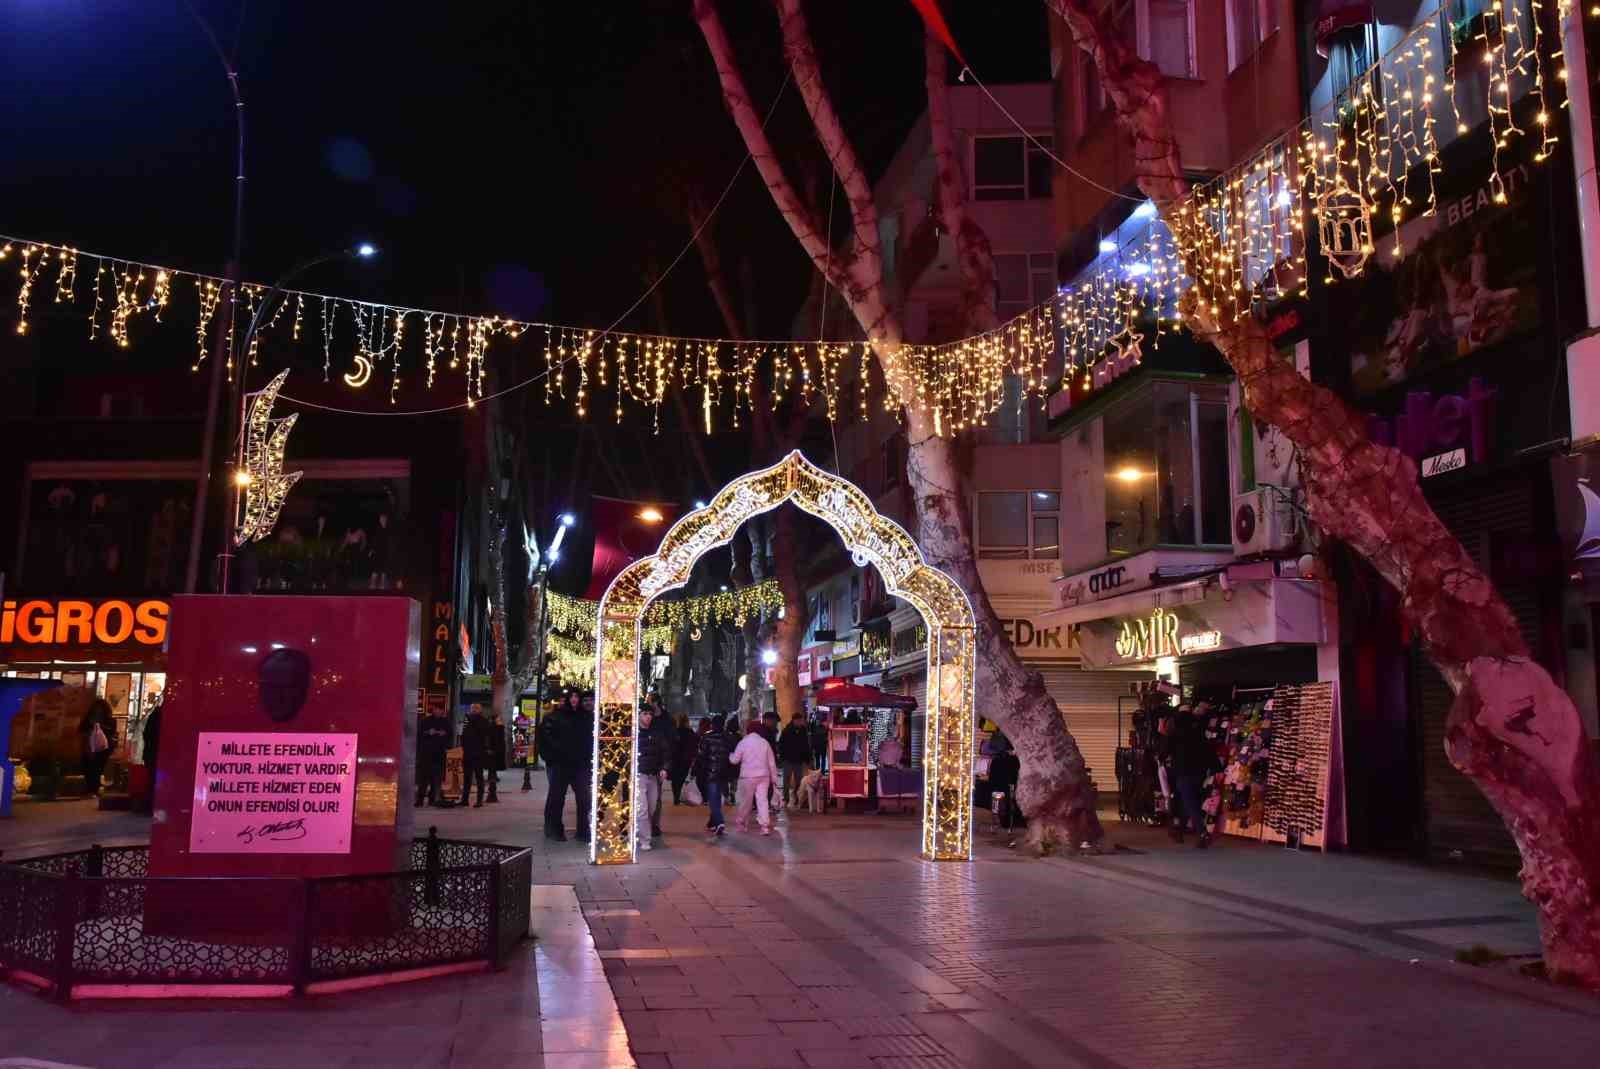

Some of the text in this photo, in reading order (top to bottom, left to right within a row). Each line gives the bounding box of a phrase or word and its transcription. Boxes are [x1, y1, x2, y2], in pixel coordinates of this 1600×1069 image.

[432, 600, 451, 685] MALL
[221, 741, 336, 757] MİLLETE EFENDİLİK
[202, 762, 254, 775] YOKTUR.
[258, 761, 301, 775] HİZMET
[209, 779, 341, 794] MİLLETE HİZMET EDEN
[208, 799, 339, 813] ONUN EFENDİSİ OLUR!
